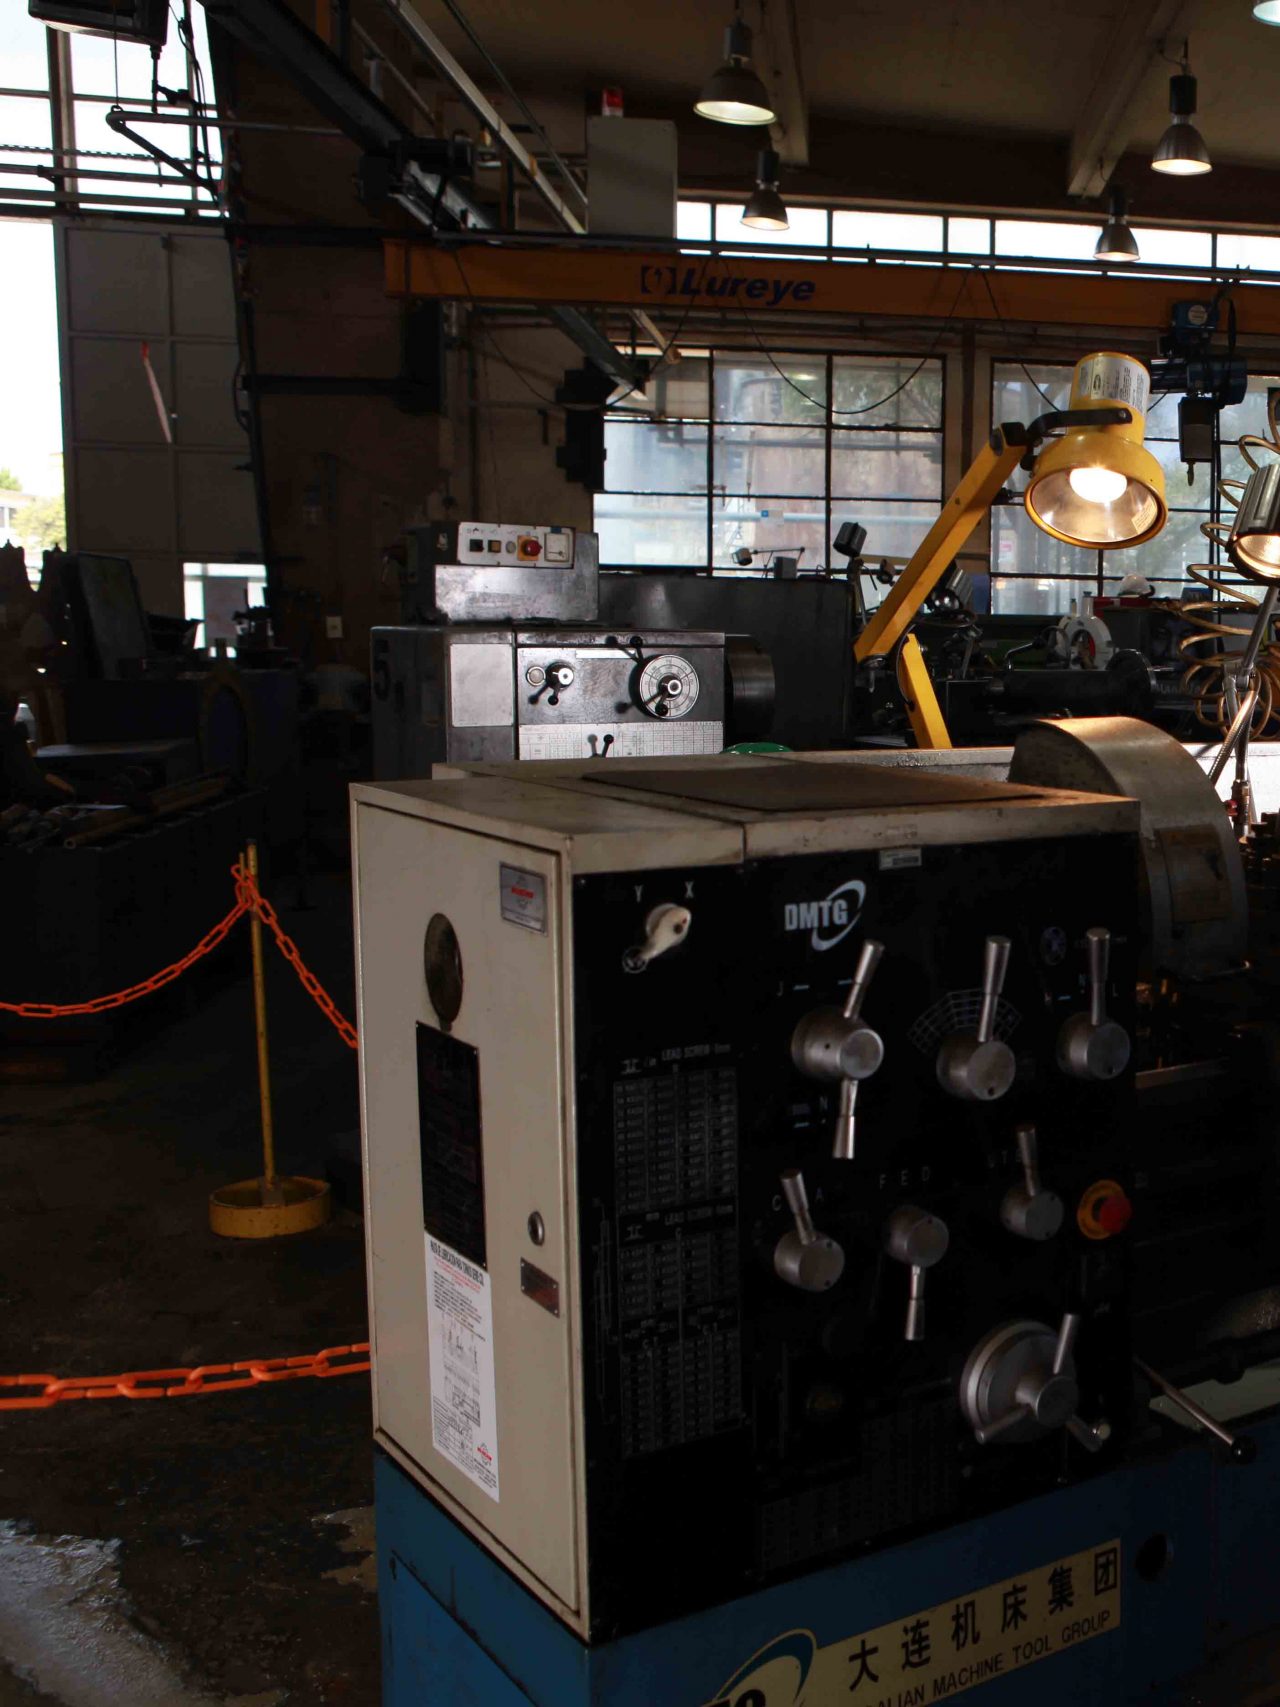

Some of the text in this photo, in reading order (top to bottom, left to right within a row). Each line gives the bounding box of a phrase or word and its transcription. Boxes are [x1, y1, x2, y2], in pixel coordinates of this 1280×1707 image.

[680, 267, 816, 306] Lureye
[633, 884, 644, 903] Y
[683, 880, 694, 899] X
[784, 899, 849, 932] DMTG
[849, 1547, 1117, 1691] 大连机床集团
[933, 1652, 1004, 1697] MACHINE
[1012, 1635, 1052, 1664] TOOL
[1061, 1609, 1111, 1645] GROUP
